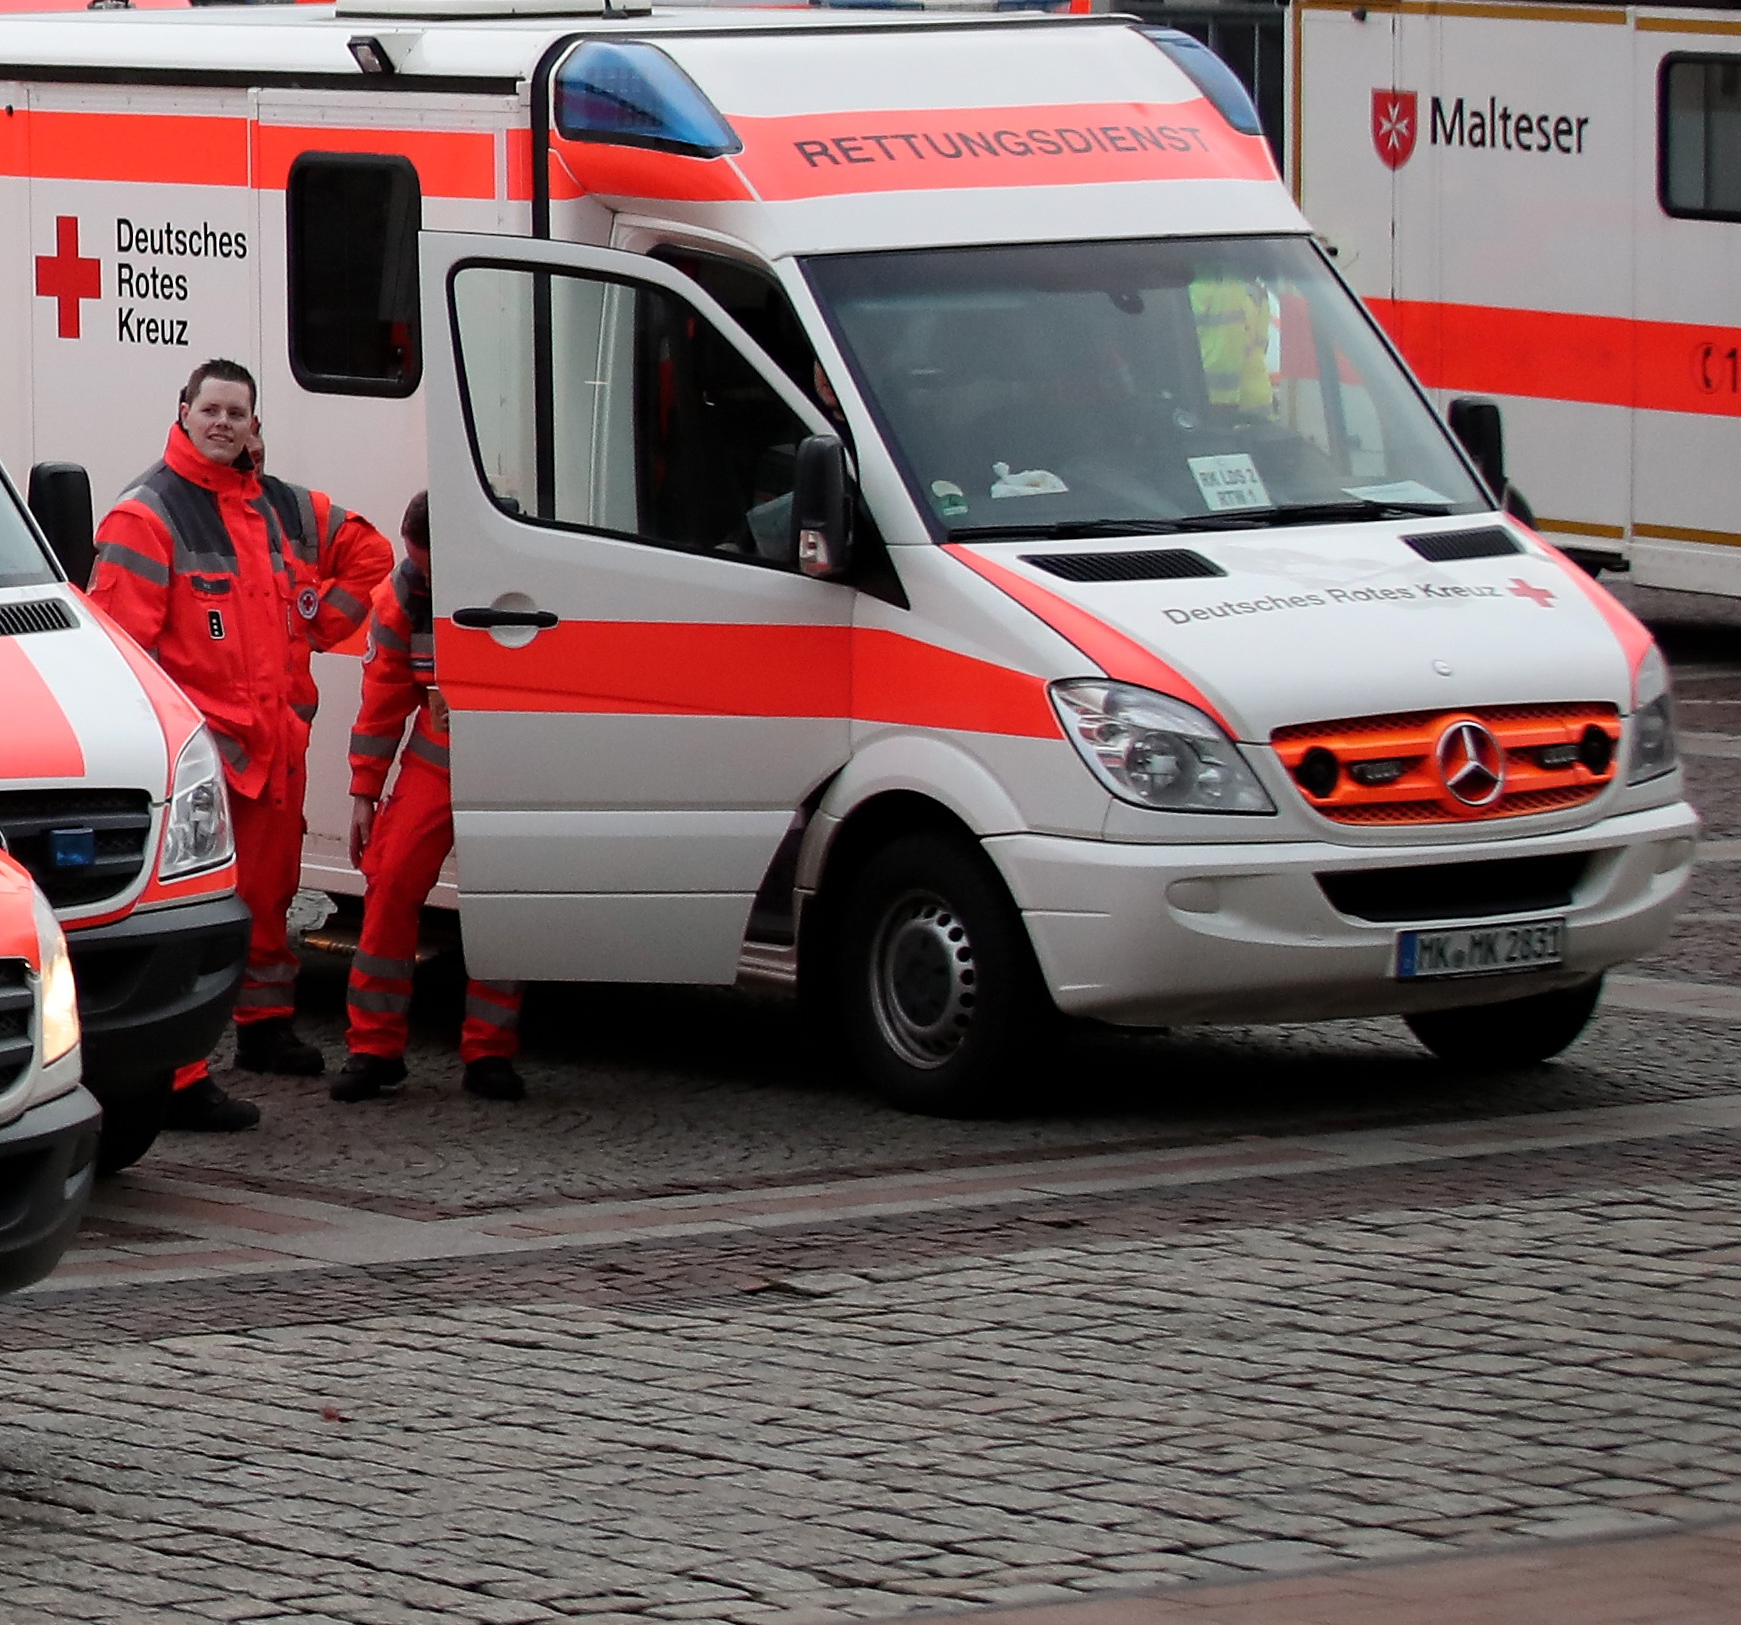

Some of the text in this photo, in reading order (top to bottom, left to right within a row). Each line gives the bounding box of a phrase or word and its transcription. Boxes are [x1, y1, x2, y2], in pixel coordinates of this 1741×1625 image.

[1429, 95, 1590, 155] Malteser
[794, 126, 1215, 170] RETTUNGSDIENST
[115, 218, 249, 260] Deutsches
[117, 263, 189, 302] Rotes
[117, 307, 190, 347] Kreuz
[1161, 582, 1502, 628] Deutsches Rotes Kreuz
[1418, 936, 1449, 969] MK
